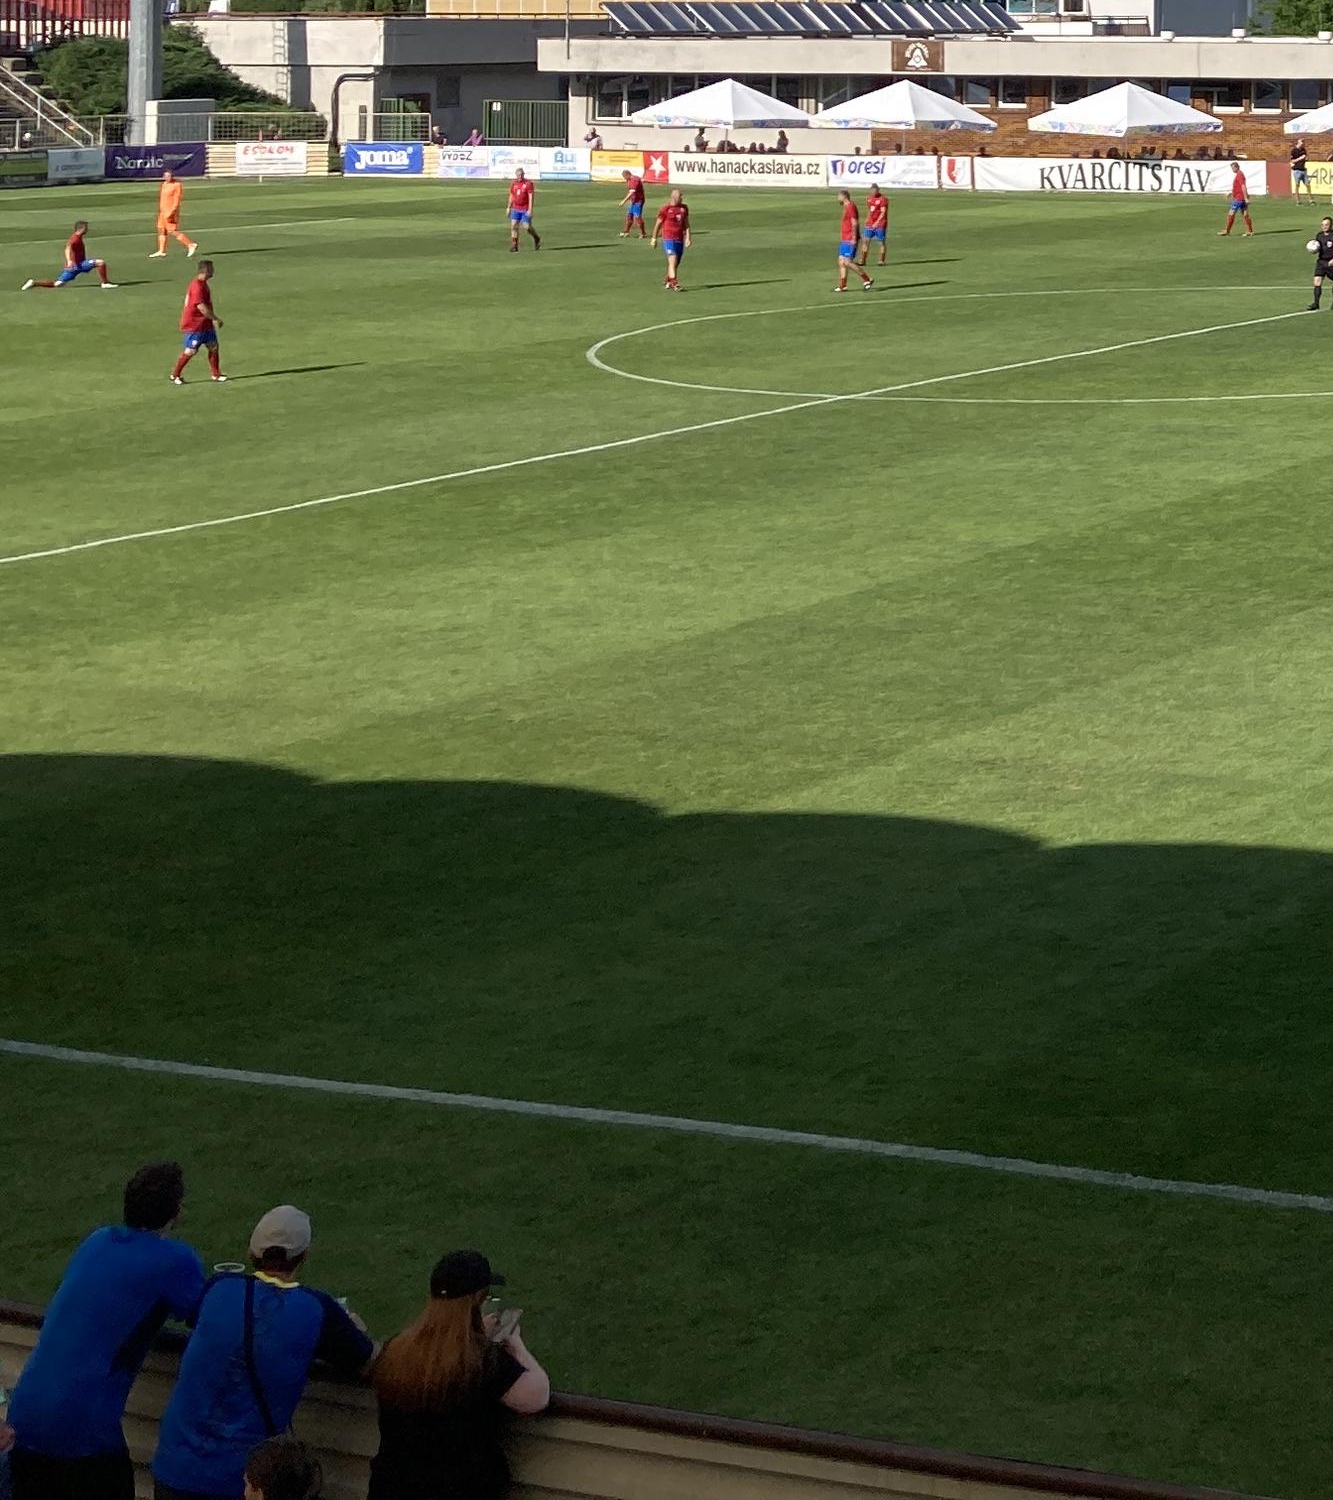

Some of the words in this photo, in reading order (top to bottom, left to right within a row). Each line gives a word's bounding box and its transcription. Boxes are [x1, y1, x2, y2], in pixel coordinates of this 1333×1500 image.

[114, 156, 164, 169] Nordic
[674, 157, 821, 176] www.hanackaslavia.cz
[847, 156, 887, 174] oresi
[1039, 161, 1212, 193] KVARCITSTAV
